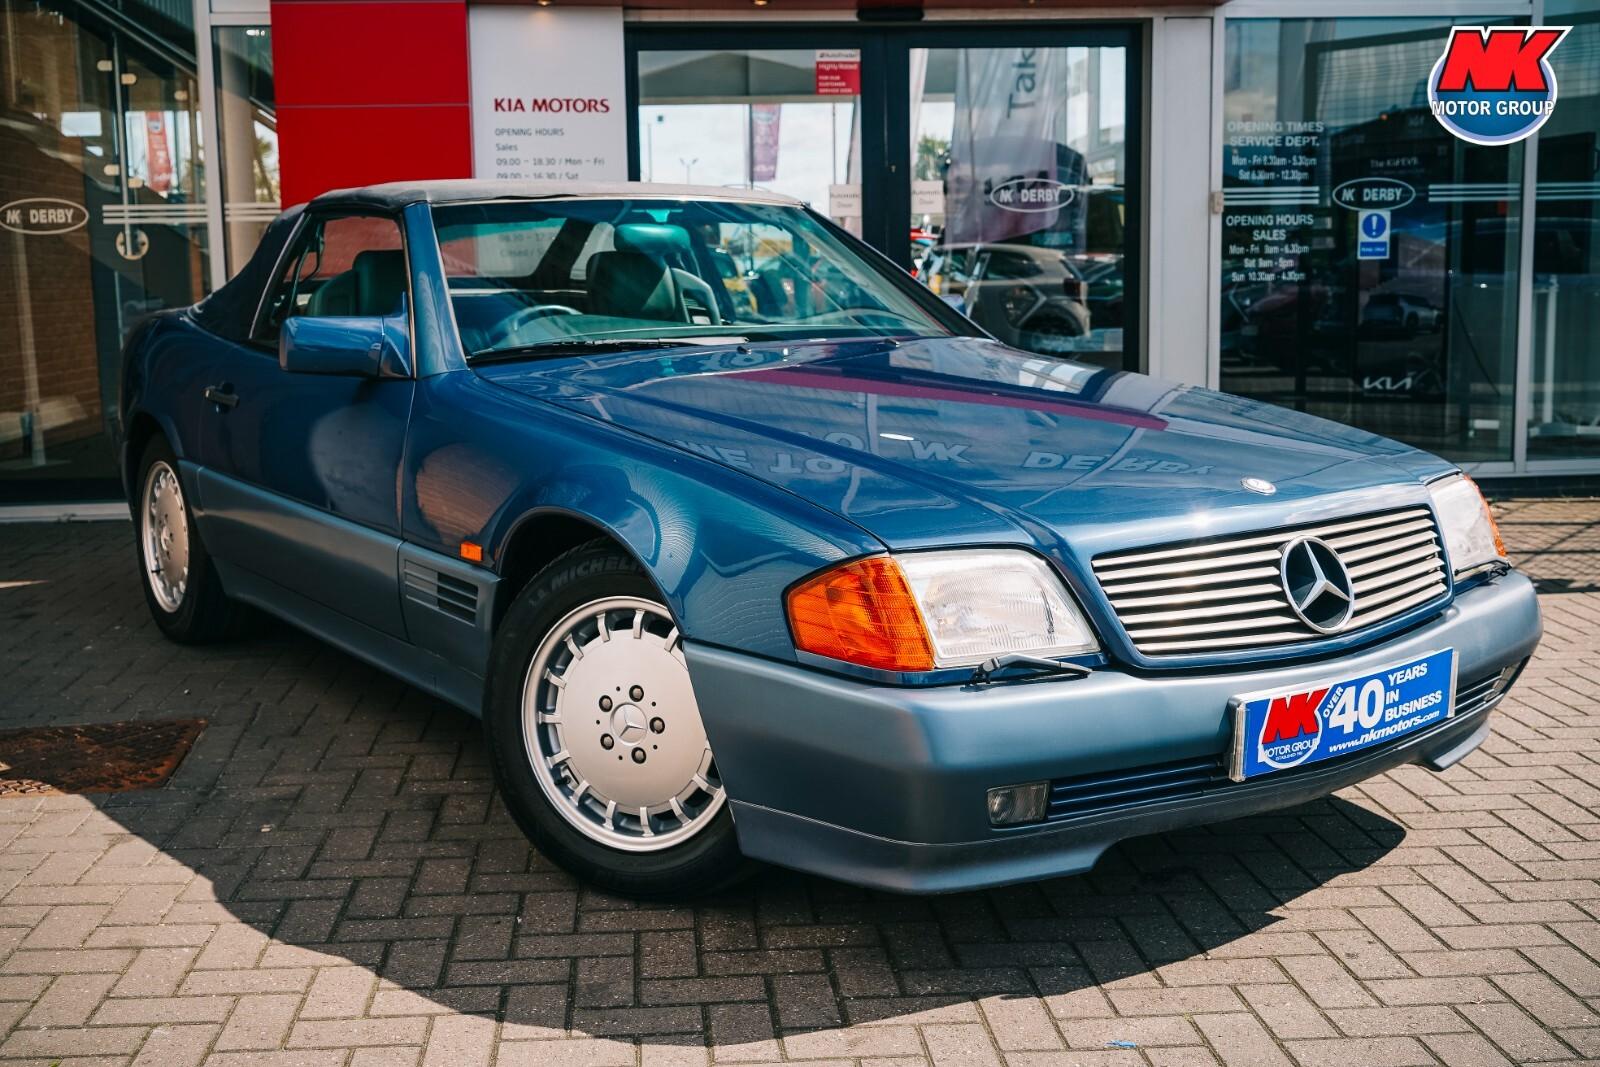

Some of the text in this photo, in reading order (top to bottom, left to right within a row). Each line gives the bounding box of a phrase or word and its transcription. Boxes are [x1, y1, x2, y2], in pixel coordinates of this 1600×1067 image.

[494, 98, 610, 113] KIA MOTORS
[494, 128, 565, 137] OPENING HOURS
[1226, 121, 1325, 133] OPENING TIMES
[1230, 135, 1320, 147] SERVICE DEPT.
[495, 143, 519, 152] Sales
[564, 157, 582, 166] Mon
[593, 157, 605, 166] Fri
[1232, 155, 1247, 166] Mon
[1252, 154, 1262, 166] Fri
[565, 172, 579, 180] Sat
[1238, 169, 1250, 180] Sat
[1020, 188, 1061, 202] DERBY
[1362, 188, 1402, 201] DERBY
[29, 208, 74, 224] DERBY
[1225, 214, 1314, 226] OPENING HOURS
[1253, 229, 1286, 241] SALES
[1229, 244, 1245, 255] Mon
[1250, 244, 1260, 255] Fri
[1244, 257, 1256, 269] Sat
[1231, 271, 1246, 282] Sun
[1388, 663, 1428, 687] YEARS
[1323, 686, 1344, 718] OVER
[1385, 688, 1400, 705] IN
[1328, 678, 1386, 735] 40
[1384, 690, 1443, 722] BUSINESS
[1262, 688, 1330, 744] NK
[1329, 710, 1440, 753] www.nkmotors.com
